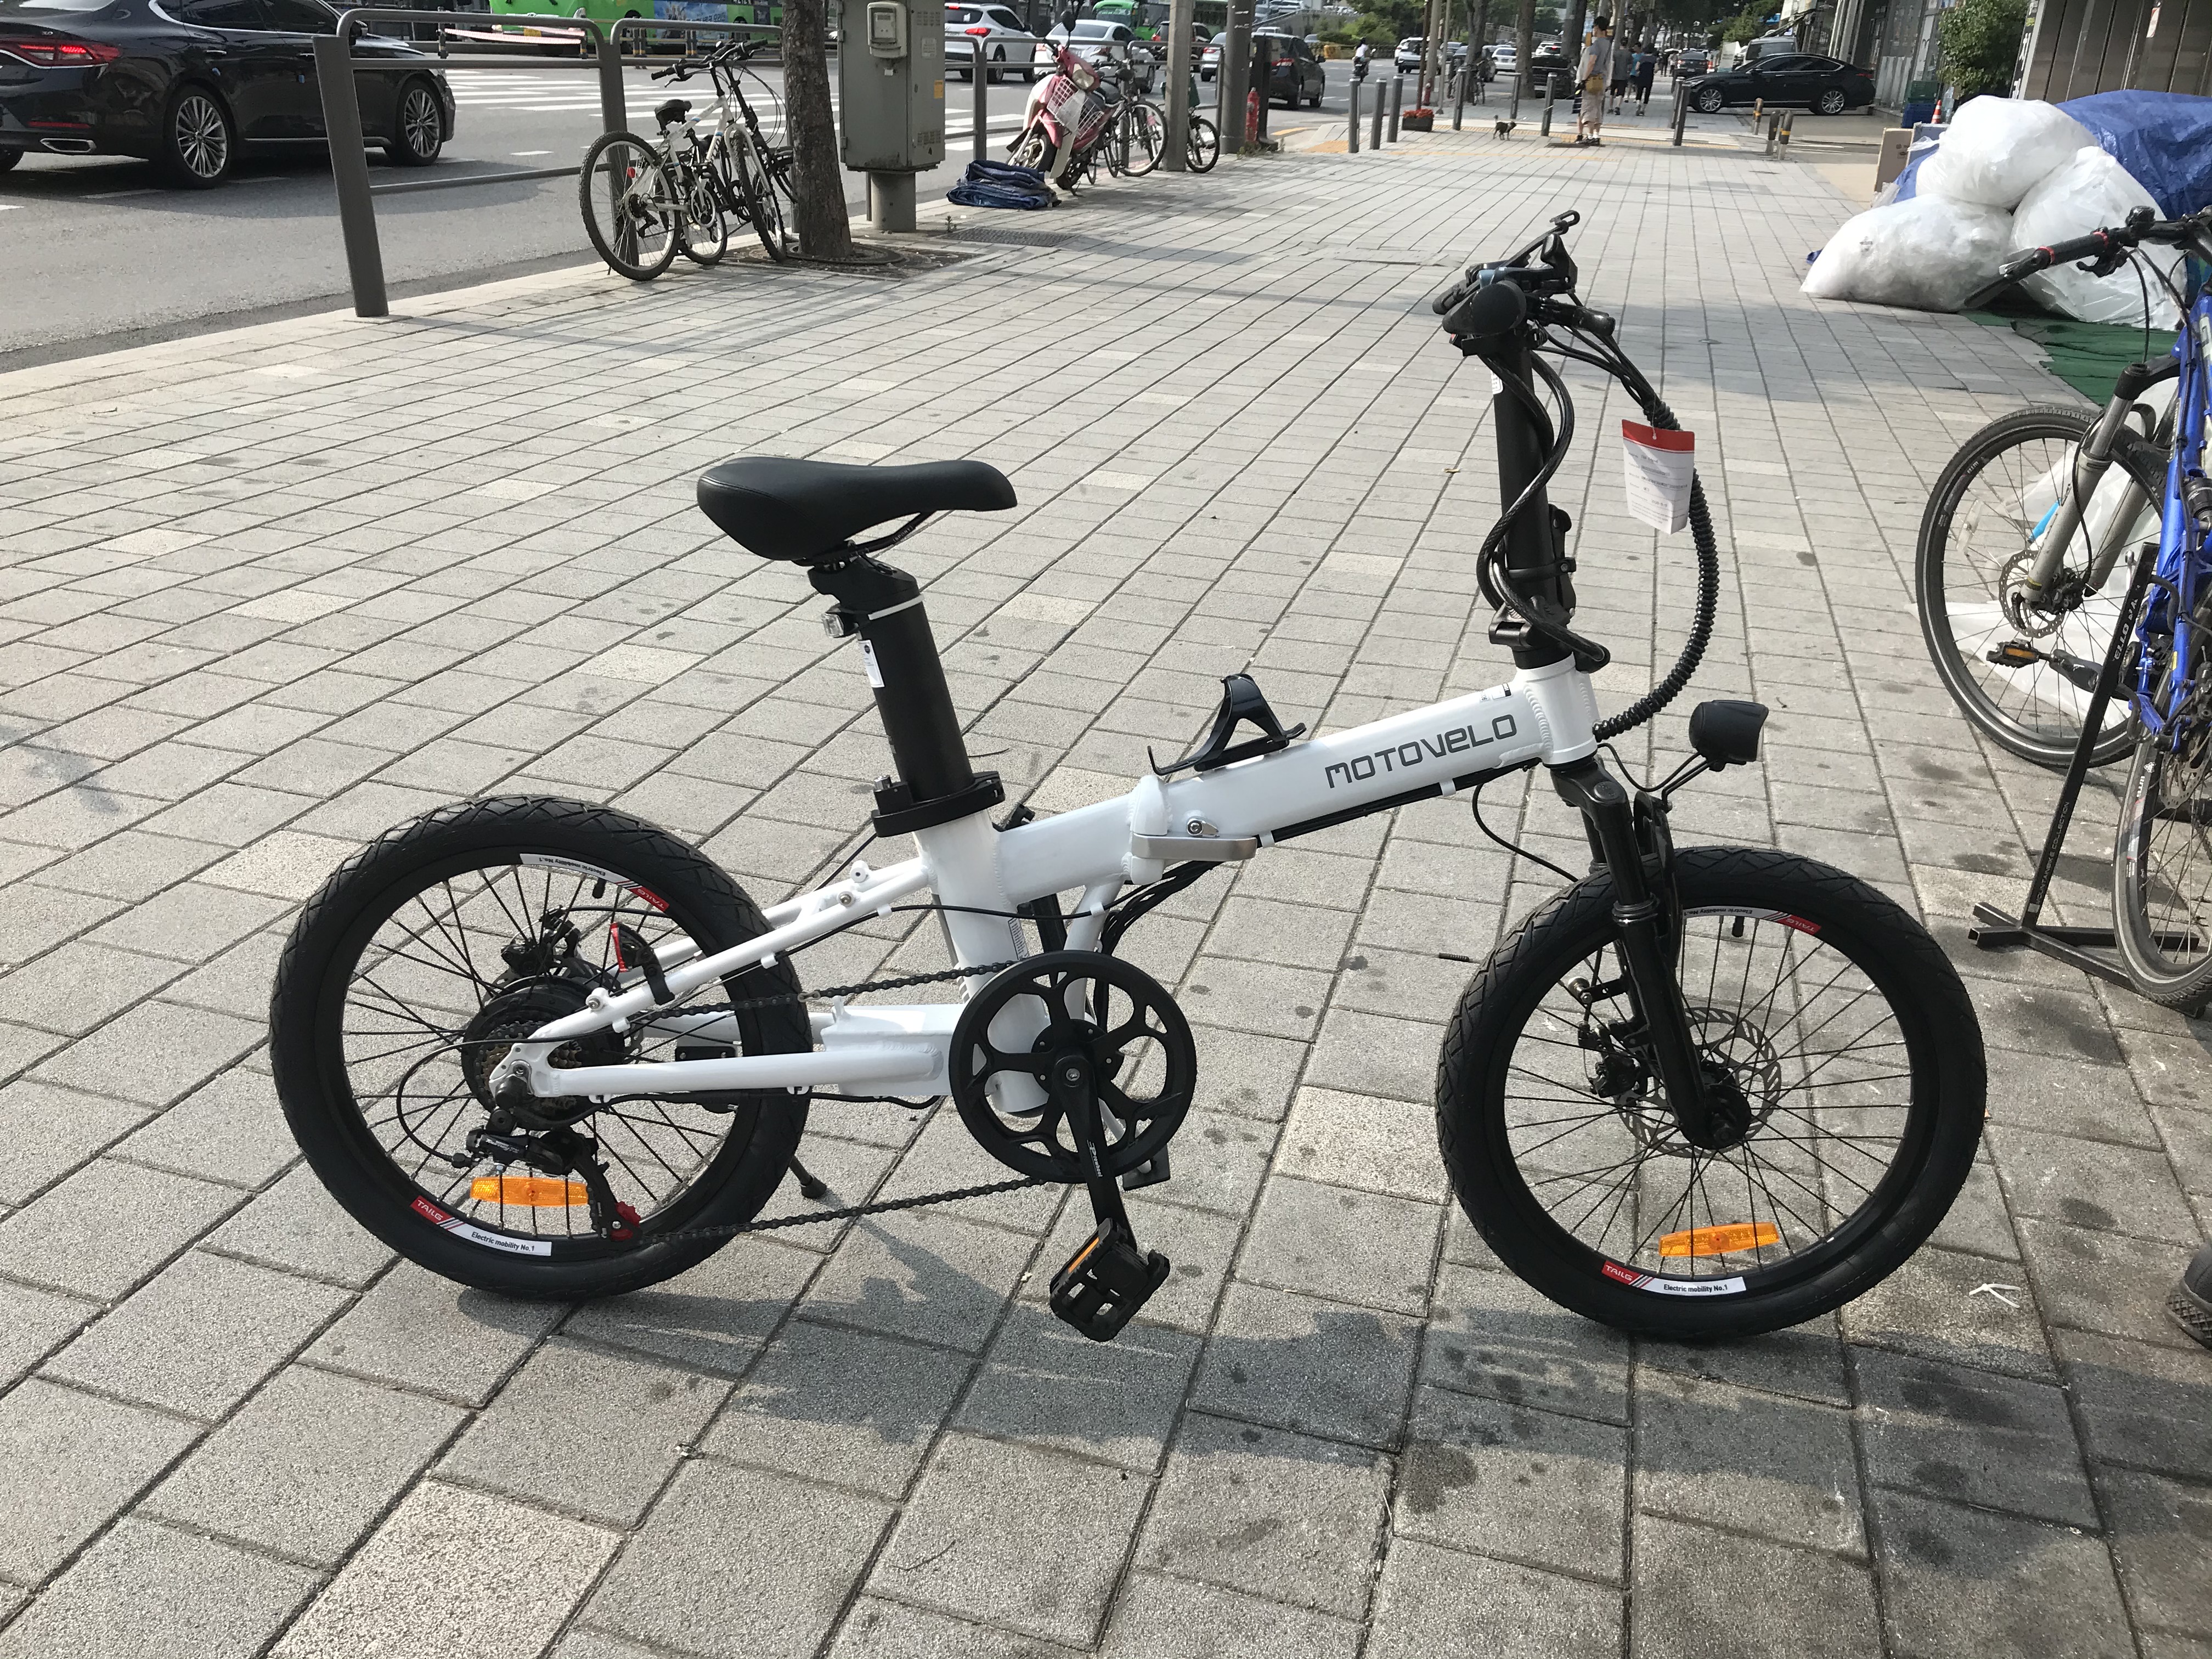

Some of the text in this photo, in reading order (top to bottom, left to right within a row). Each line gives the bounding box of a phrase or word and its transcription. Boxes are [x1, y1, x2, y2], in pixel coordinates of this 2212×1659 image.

[1325, 714, 1517, 789] MOTOVELO
[555, 858, 581, 868] mobility
[582, 865, 606, 876] Electric
[637, 888, 665, 909] TAILG
[1785, 918, 1814, 932] TAILG
[417, 1199, 443, 1221] TAILG
[471, 1231, 494, 1244] Electric
[495, 1239, 520, 1251] mobility
[1605, 1264, 1633, 1281] TAILG
[1663, 1284, 1686, 1293] Electric
[1688, 1284, 1712, 1293] mobility
